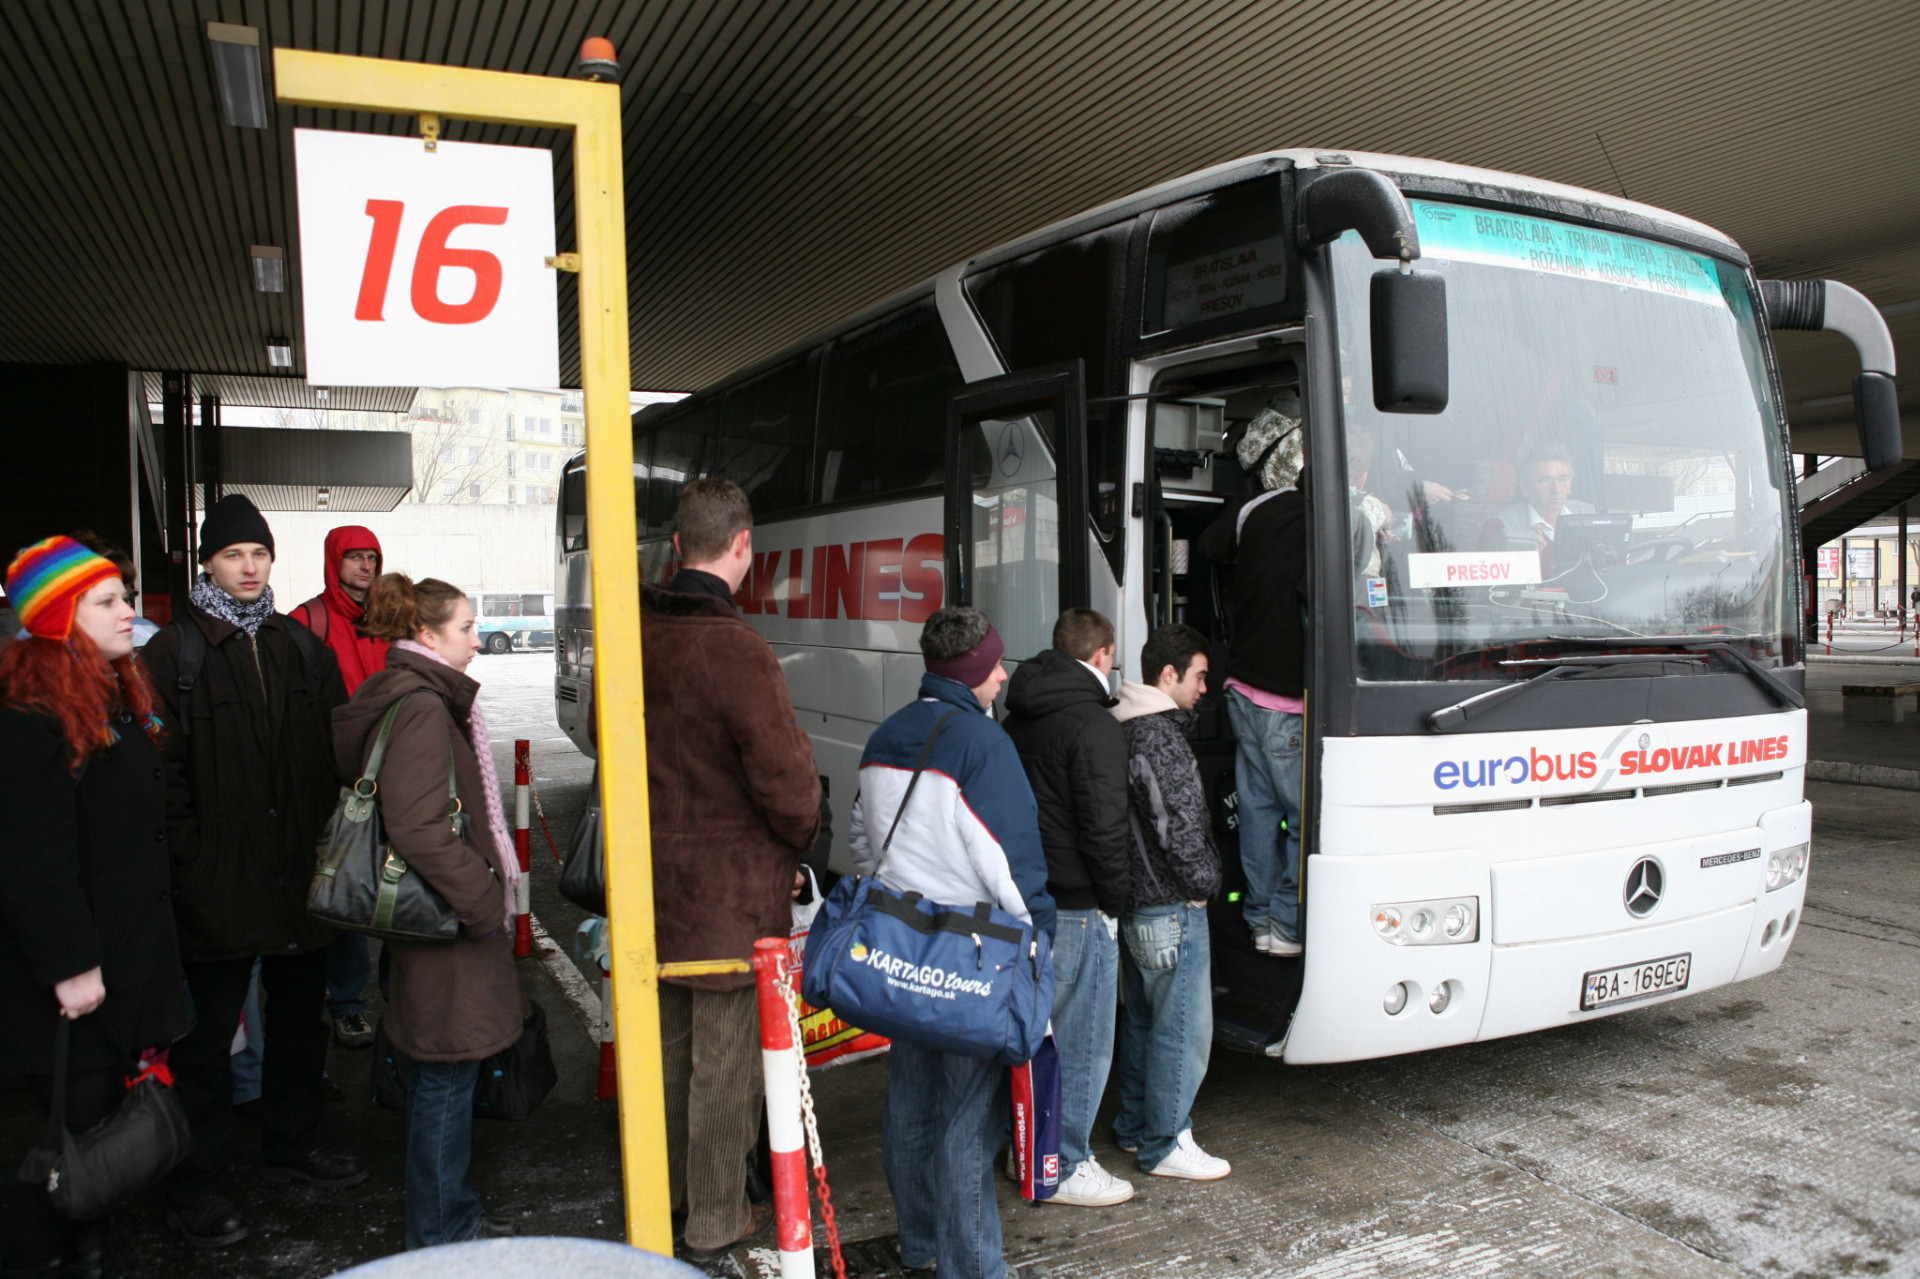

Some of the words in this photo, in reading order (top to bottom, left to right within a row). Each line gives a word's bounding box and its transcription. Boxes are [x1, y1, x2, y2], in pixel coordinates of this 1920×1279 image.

[355, 198, 509, 325] 16
[1192, 249, 1257, 279] BRATISLAVA
[1475, 214, 1554, 245] BRATISLAVA
[1566, 230, 1612, 257] TRNAVA
[1622, 241, 1656, 265] NITRA
[1199, 292, 1244, 317] PREŠOV
[787, 533, 944, 624] LINES
[1446, 560, 1511, 582] PREŠOV
[1433, 746, 1599, 791] eurobus
[1619, 742, 1723, 776] SLOVAK
[1727, 735, 1789, 767] LINES
[1702, 849, 1761, 868] MERCEDES-BENZ
[867, 948, 944, 987] KARTAGO
[944, 971, 992, 997] tours
[887, 975, 956, 1001] www.kartago.sk
[1016, 1102, 1026, 1181] www.emos.eu
